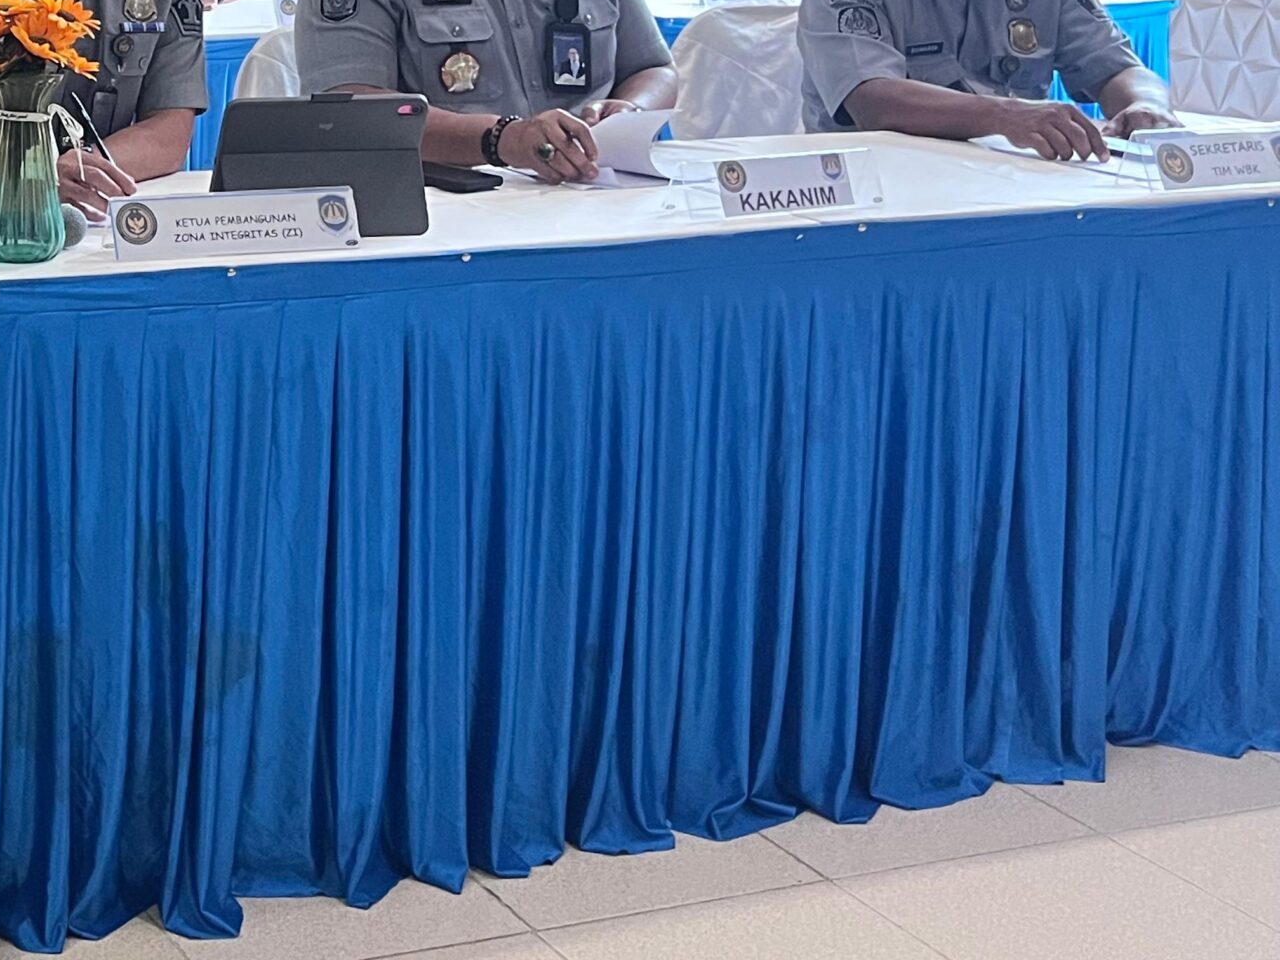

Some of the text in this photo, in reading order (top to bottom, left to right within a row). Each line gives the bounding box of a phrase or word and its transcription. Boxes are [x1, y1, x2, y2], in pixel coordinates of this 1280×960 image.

[1189, 141, 1265, 156] SEKRETARIS
[1211, 164, 1261, 176] TIM WBK
[739, 186, 836, 212] KAKANIM
[175, 213, 297, 227] KETUA PEMBANGUNAN
[174, 227, 303, 243] ZONA INTEGRITAS (ZI)
